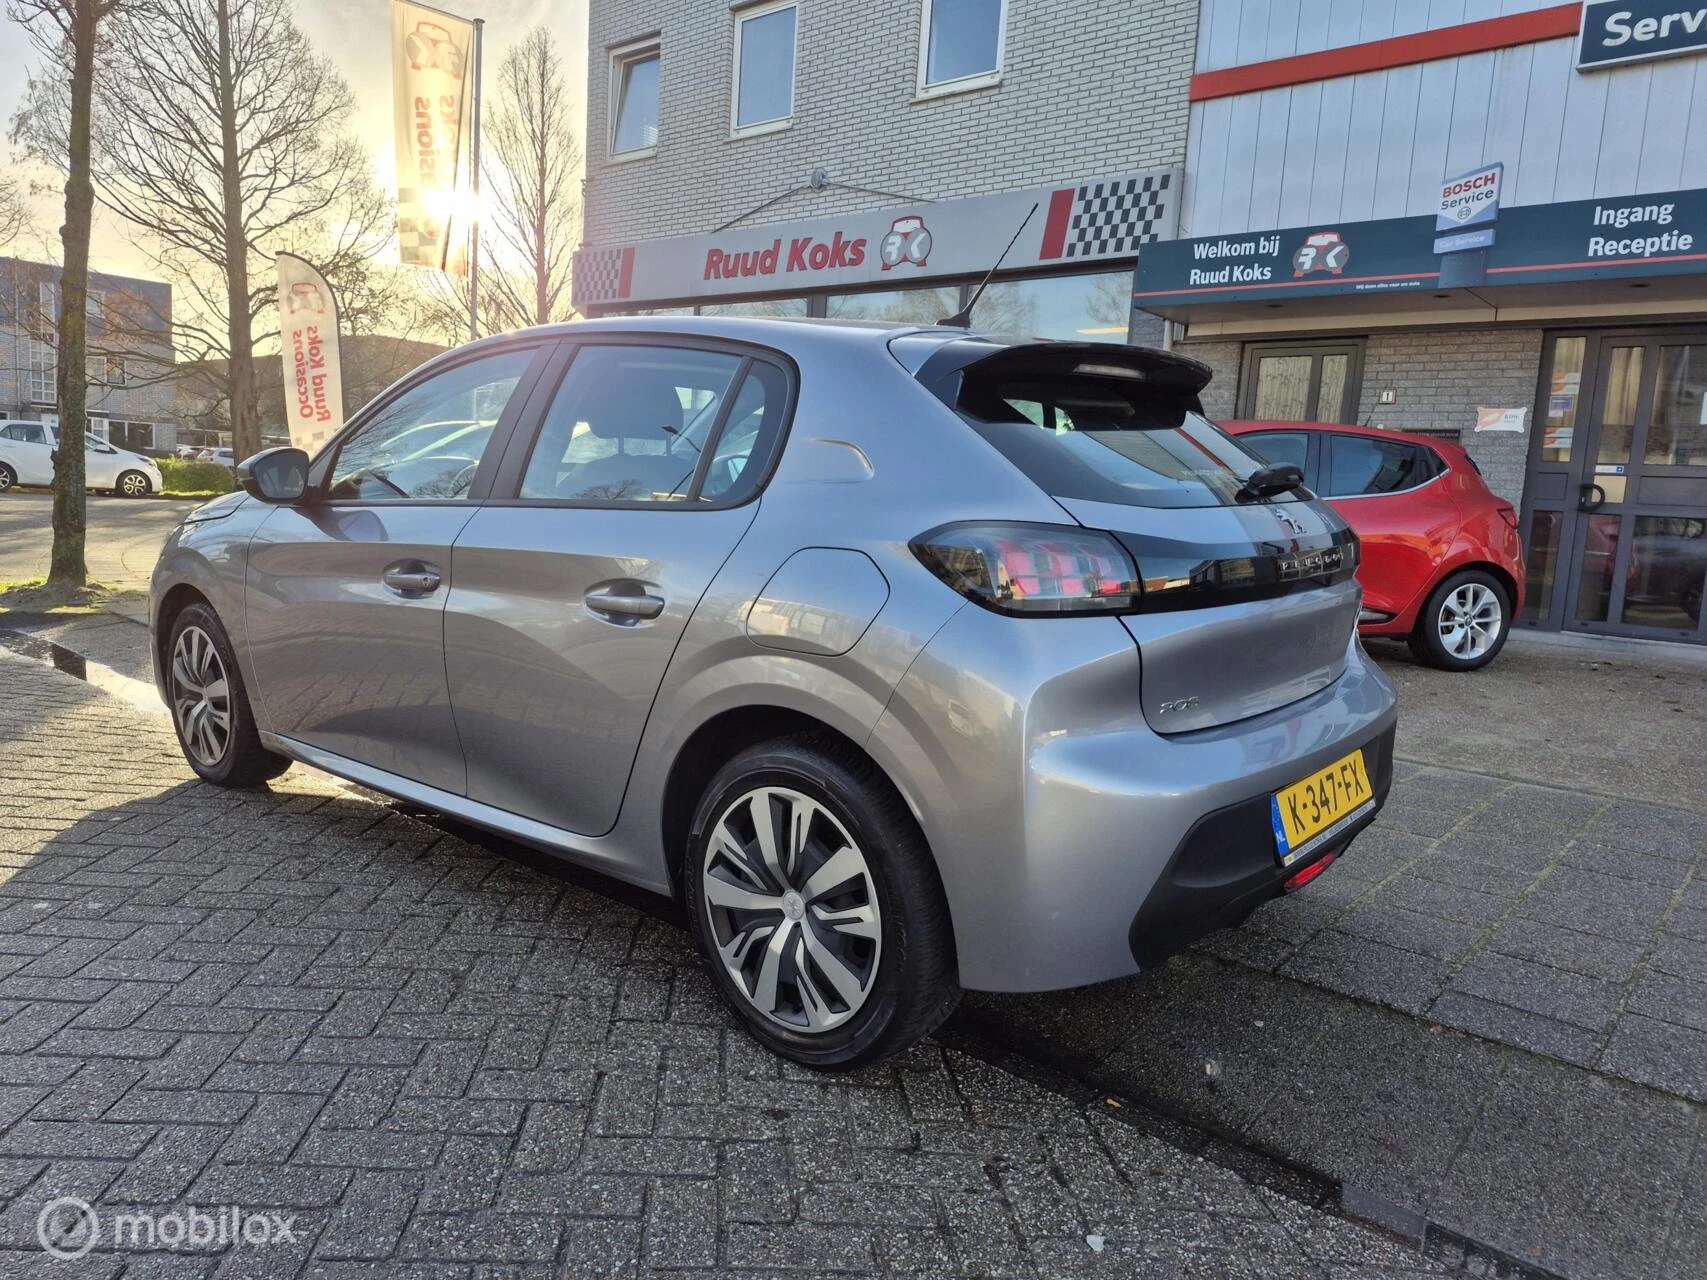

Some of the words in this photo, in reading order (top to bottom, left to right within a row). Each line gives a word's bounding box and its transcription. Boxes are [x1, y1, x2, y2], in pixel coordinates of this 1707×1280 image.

[1443, 172, 1496, 198] BOSCH
[1441, 189, 1494, 210] Service
[1593, 203, 1675, 228] Ingang
[1193, 240, 1255, 260] Welkom
[1258, 235, 1281, 257] bij
[1588, 229, 1693, 257] Receptie
[703, 239, 782, 281] Ruud
[786, 231, 867, 272] Koks
[1189, 266, 1230, 285] Ruud
[1230, 264, 1272, 282] Koks
[1287, 759, 1364, 835] K-347-FX
